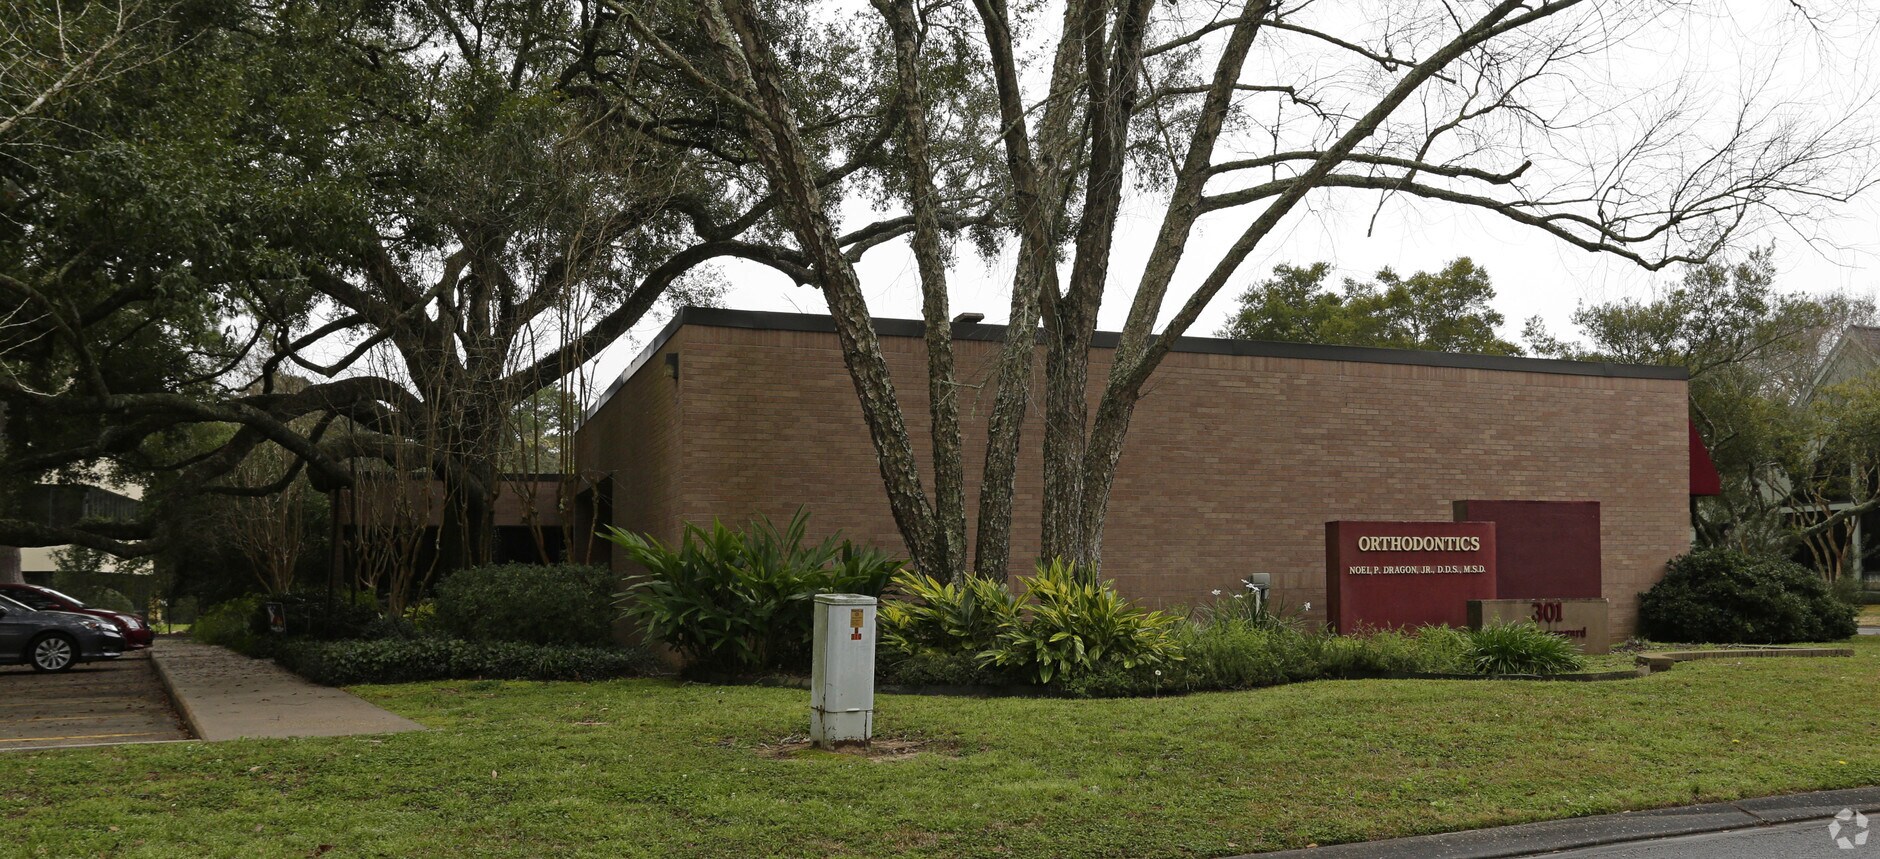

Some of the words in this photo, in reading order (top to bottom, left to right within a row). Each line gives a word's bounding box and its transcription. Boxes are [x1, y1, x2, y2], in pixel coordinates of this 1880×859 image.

[1358, 536, 1480, 551] ORTHODONTICS
[1373, 566, 1381, 574] P.
[1420, 565, 1435, 574] JR.,
[1463, 565, 1486, 574] M.S.D.
[1531, 601, 1563, 623] 301
